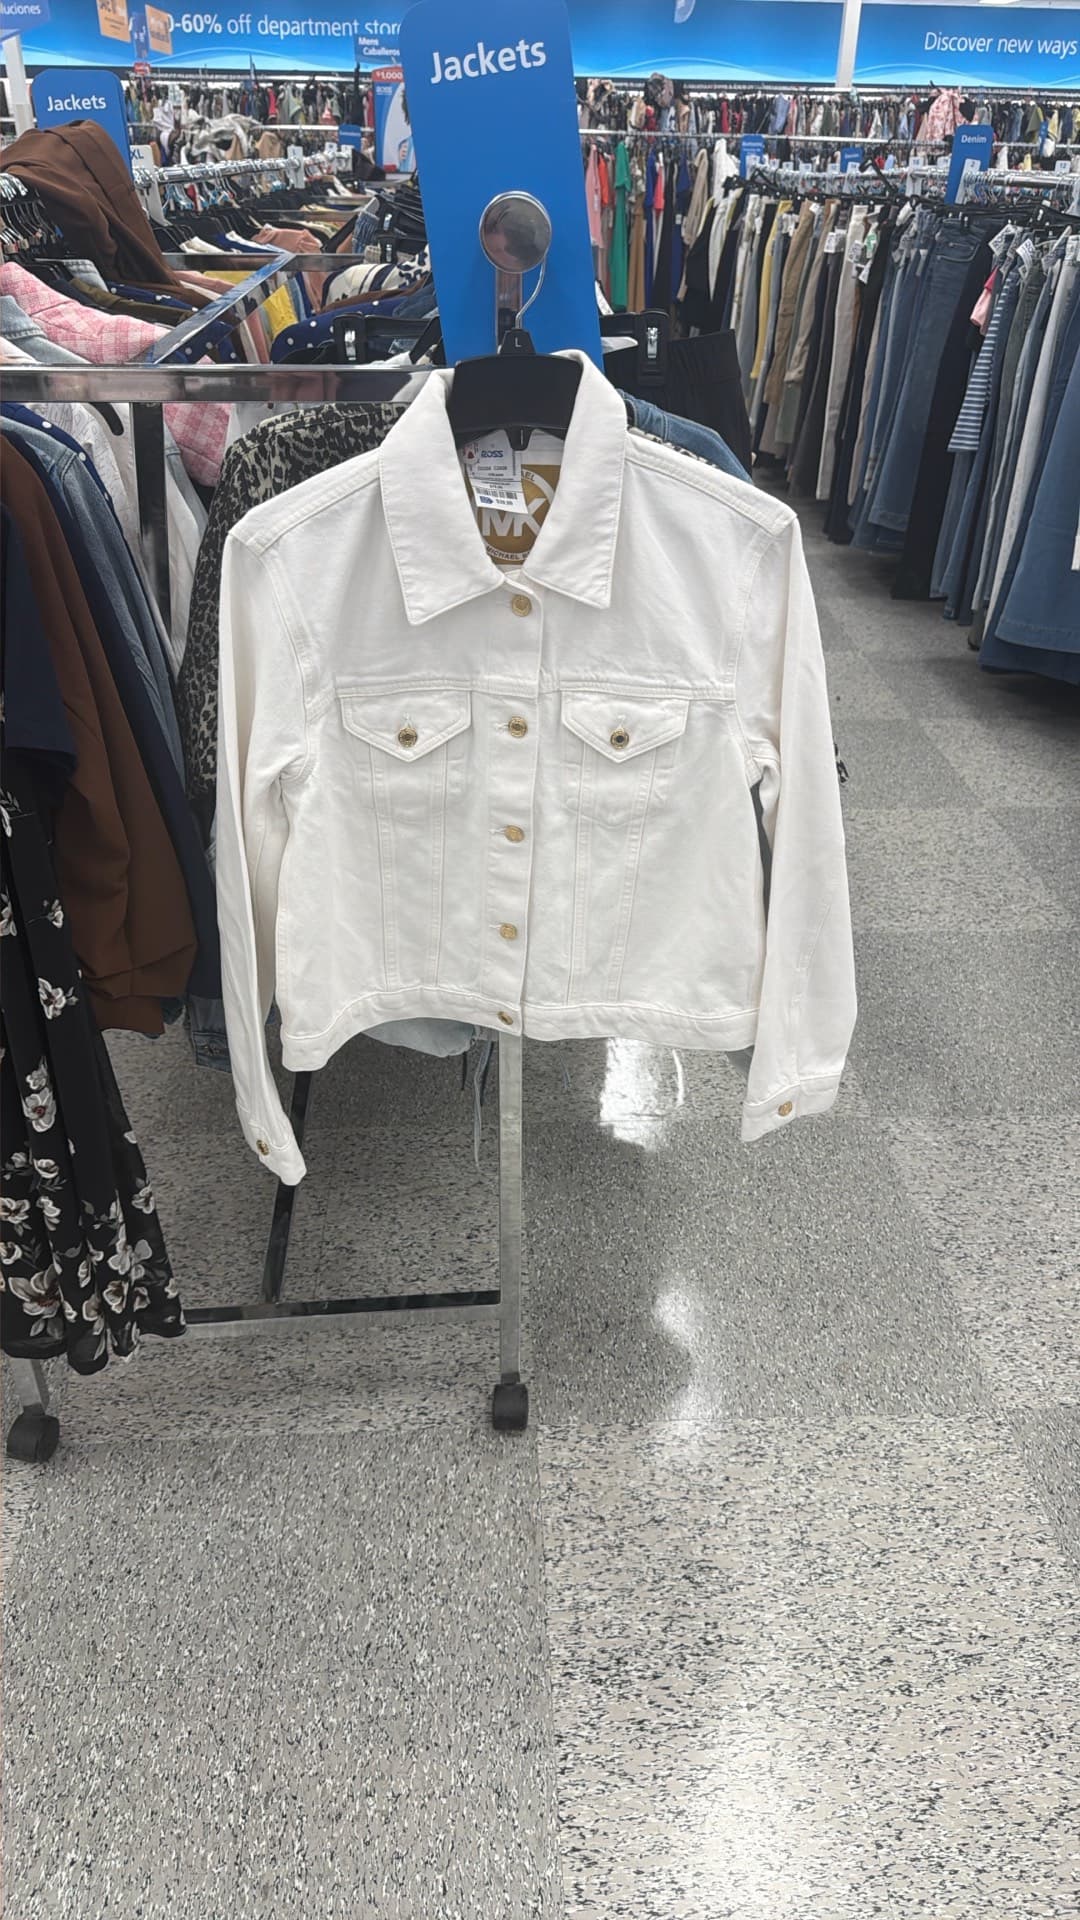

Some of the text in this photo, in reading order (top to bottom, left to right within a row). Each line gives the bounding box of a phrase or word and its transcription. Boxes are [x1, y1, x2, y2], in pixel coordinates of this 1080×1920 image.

[227, 14, 251, 34] off
[258, 15, 359, 39] department
[358, 37, 379, 46] Mens
[924, 31, 1078, 60] Discover new ways
[430, 39, 547, 85] Jackets
[47, 95, 107, 113] Jackets
[961, 134, 987, 144] Denim
[130, 148, 145, 160] XL
[515, 338, 521, 348] L
[481, 450, 504, 458] ROSS
[481, 498, 547, 537] MK
